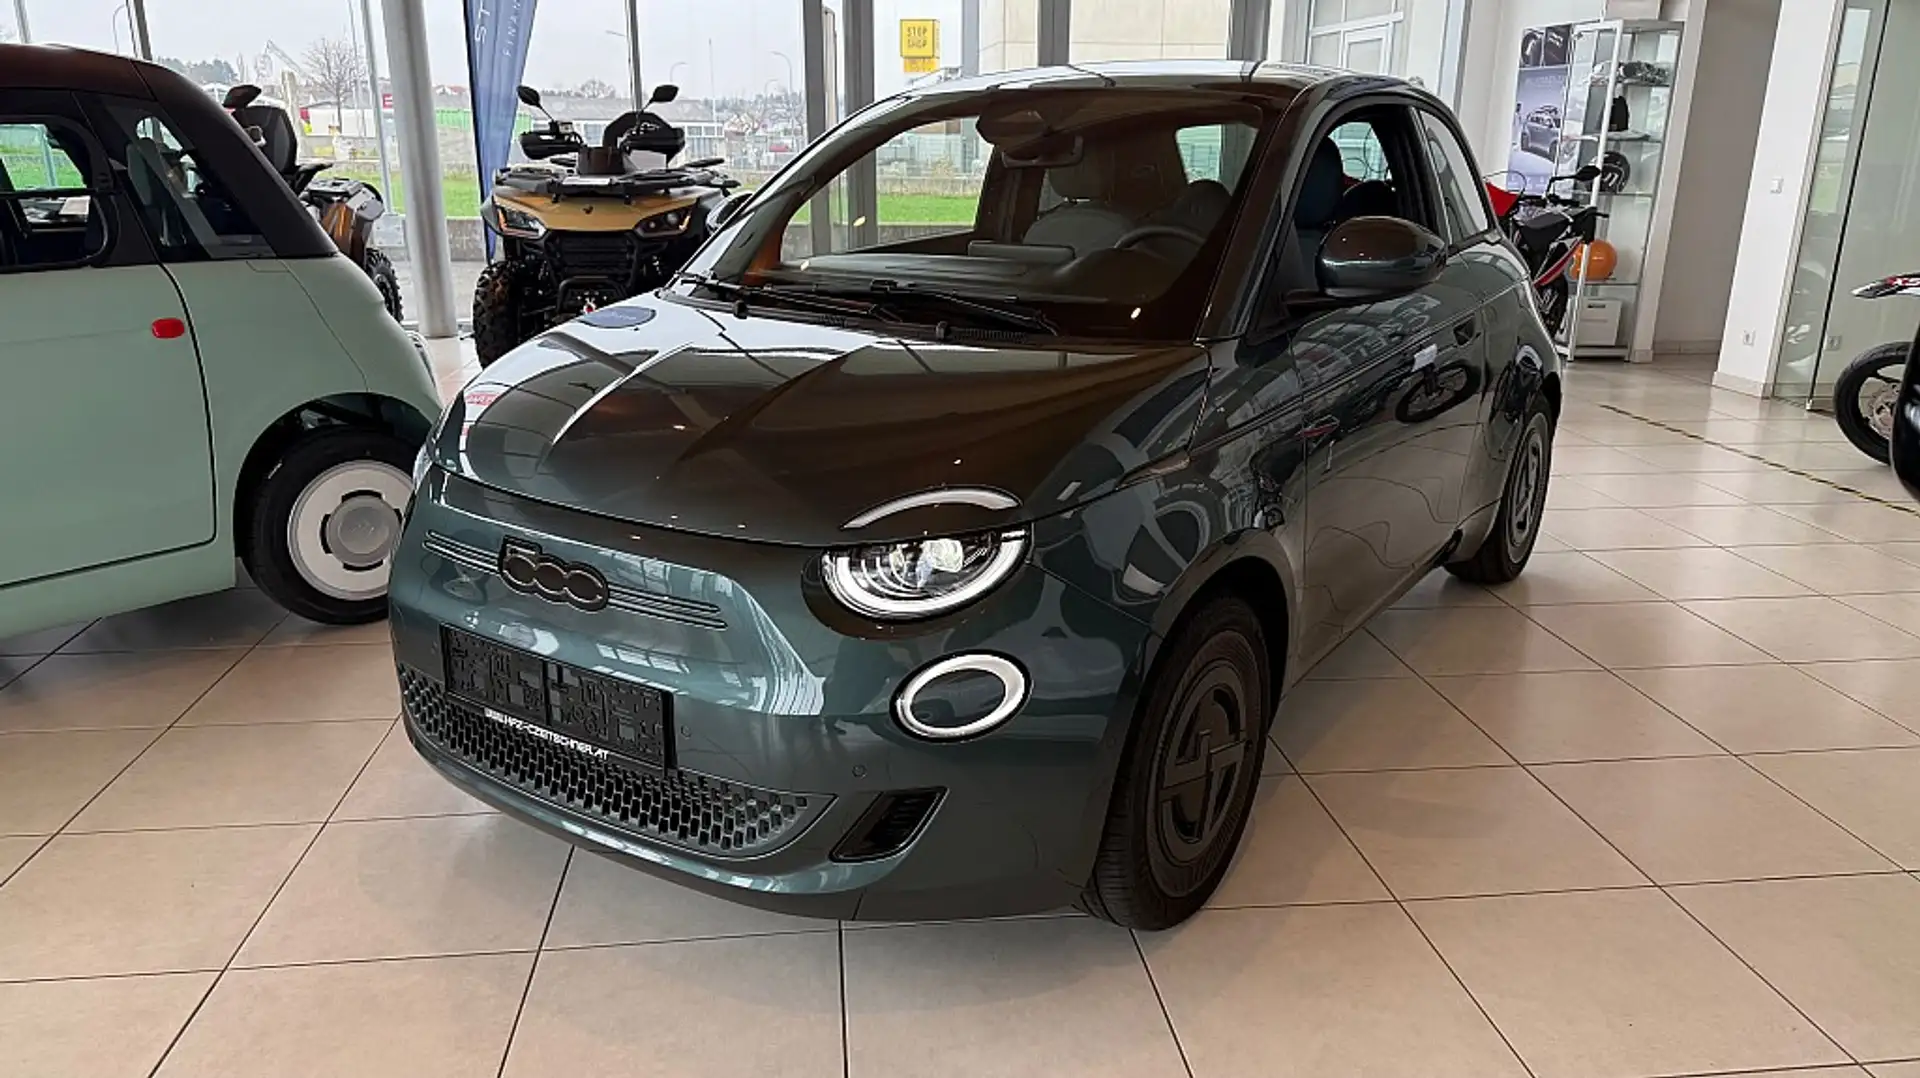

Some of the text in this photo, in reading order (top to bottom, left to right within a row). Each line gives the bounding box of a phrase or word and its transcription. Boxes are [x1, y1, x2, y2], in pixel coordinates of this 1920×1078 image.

[906, 25, 928, 37] STOP
[906, 37, 928, 49] SHOP
[501, 536, 607, 610] 500
